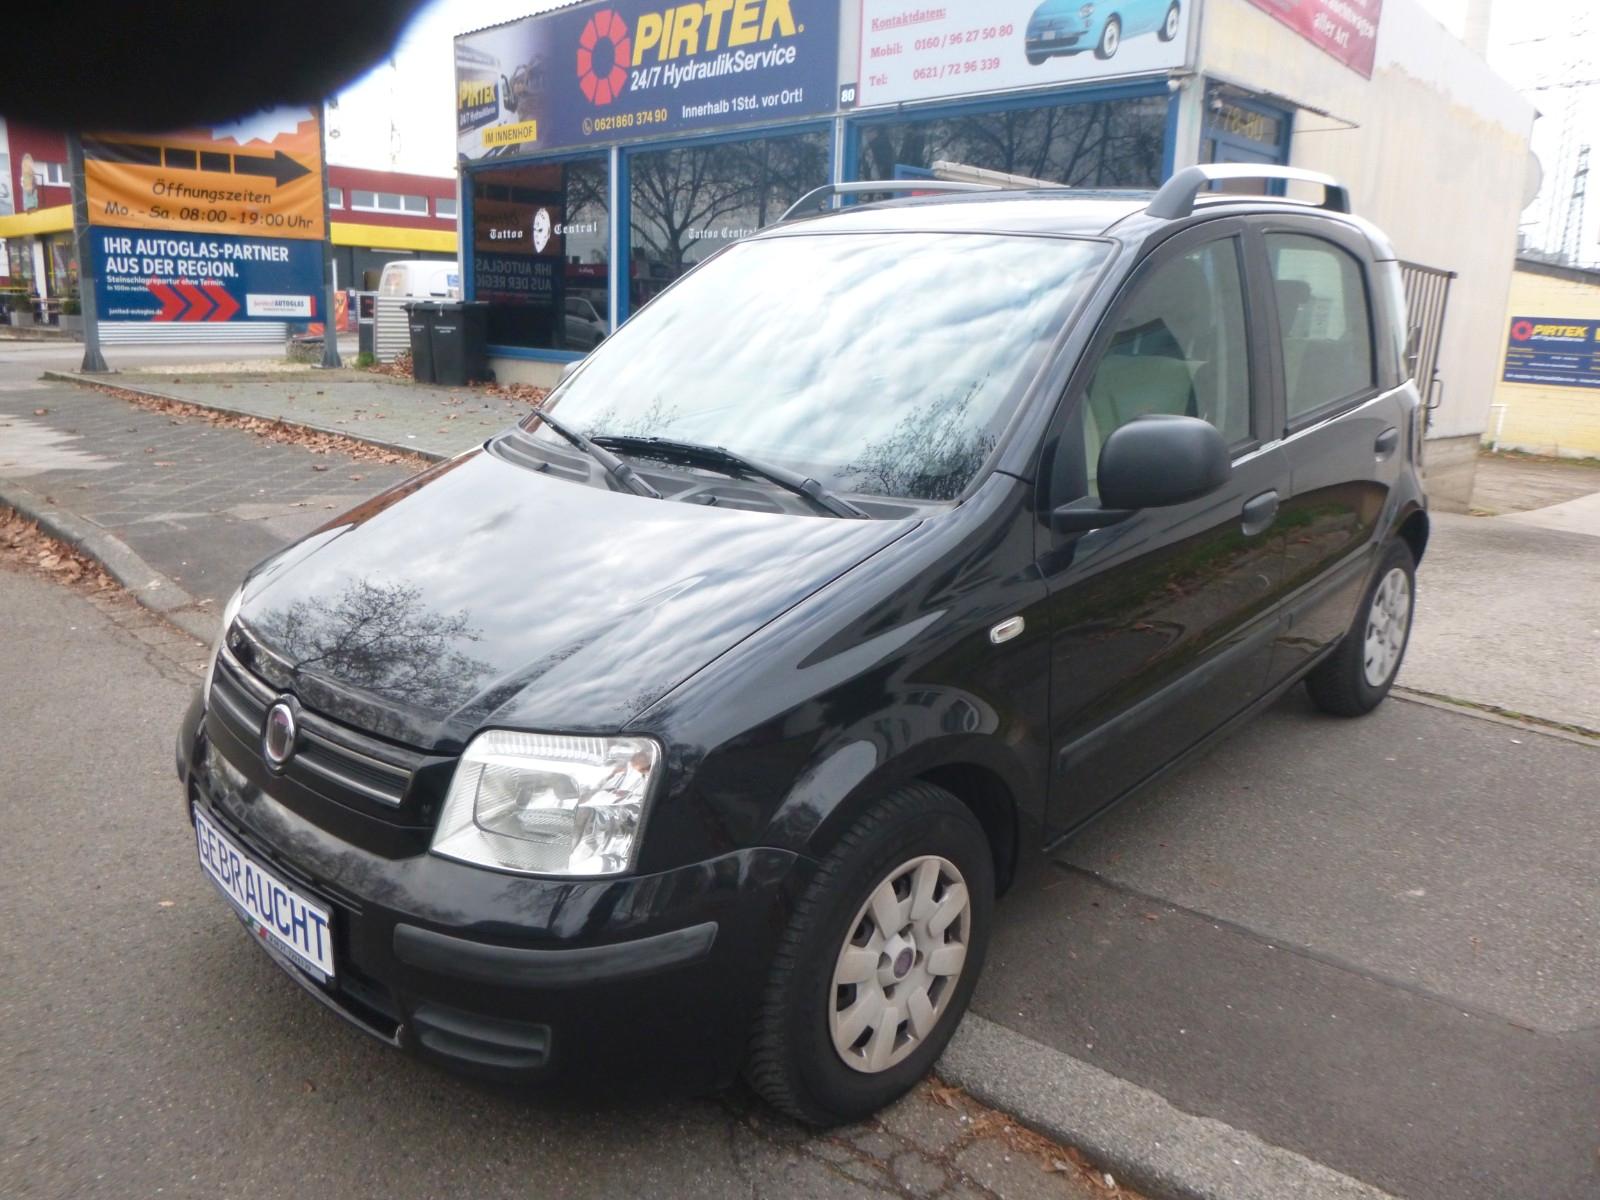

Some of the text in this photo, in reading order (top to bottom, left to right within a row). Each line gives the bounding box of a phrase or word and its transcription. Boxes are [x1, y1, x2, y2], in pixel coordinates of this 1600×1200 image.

[872, 8, 946, 31] Kontaktdaten:
[631, 0, 796, 67] PIRTEK
[870, 43, 903, 58] Mobil:
[914, 37, 939, 51] 0160
[950, 32, 963, 45] 96
[965, 29, 979, 43] 27
[982, 28, 996, 40] 50
[999, 24, 1013, 38] 80
[630, 44, 796, 91] 24/7 HydraulikService
[869, 74, 888, 87] Tel:
[913, 68, 937, 81] 0621
[948, 63, 960, 75] 72
[964, 60, 977, 73] 96
[980, 57, 1000, 71] 339
[682, 89, 803, 118] Innerhalb 1Std. vor Ort!
[841, 89, 855, 102] 80
[485, 126, 534, 145] IM INNENHOF
[152, 178, 272, 204] Öffnungszeiten
[287, 216, 313, 229] Uhr
[490, 221, 597, 240] Tattoo Central
[104, 236, 289, 262] IHR AUTOGLAS-PARTNER
[106, 256, 239, 278] AUS DER REGION.
[1532, 324, 1588, 337] PIRTEK
[197, 816, 328, 961] GEBRAUCHT
